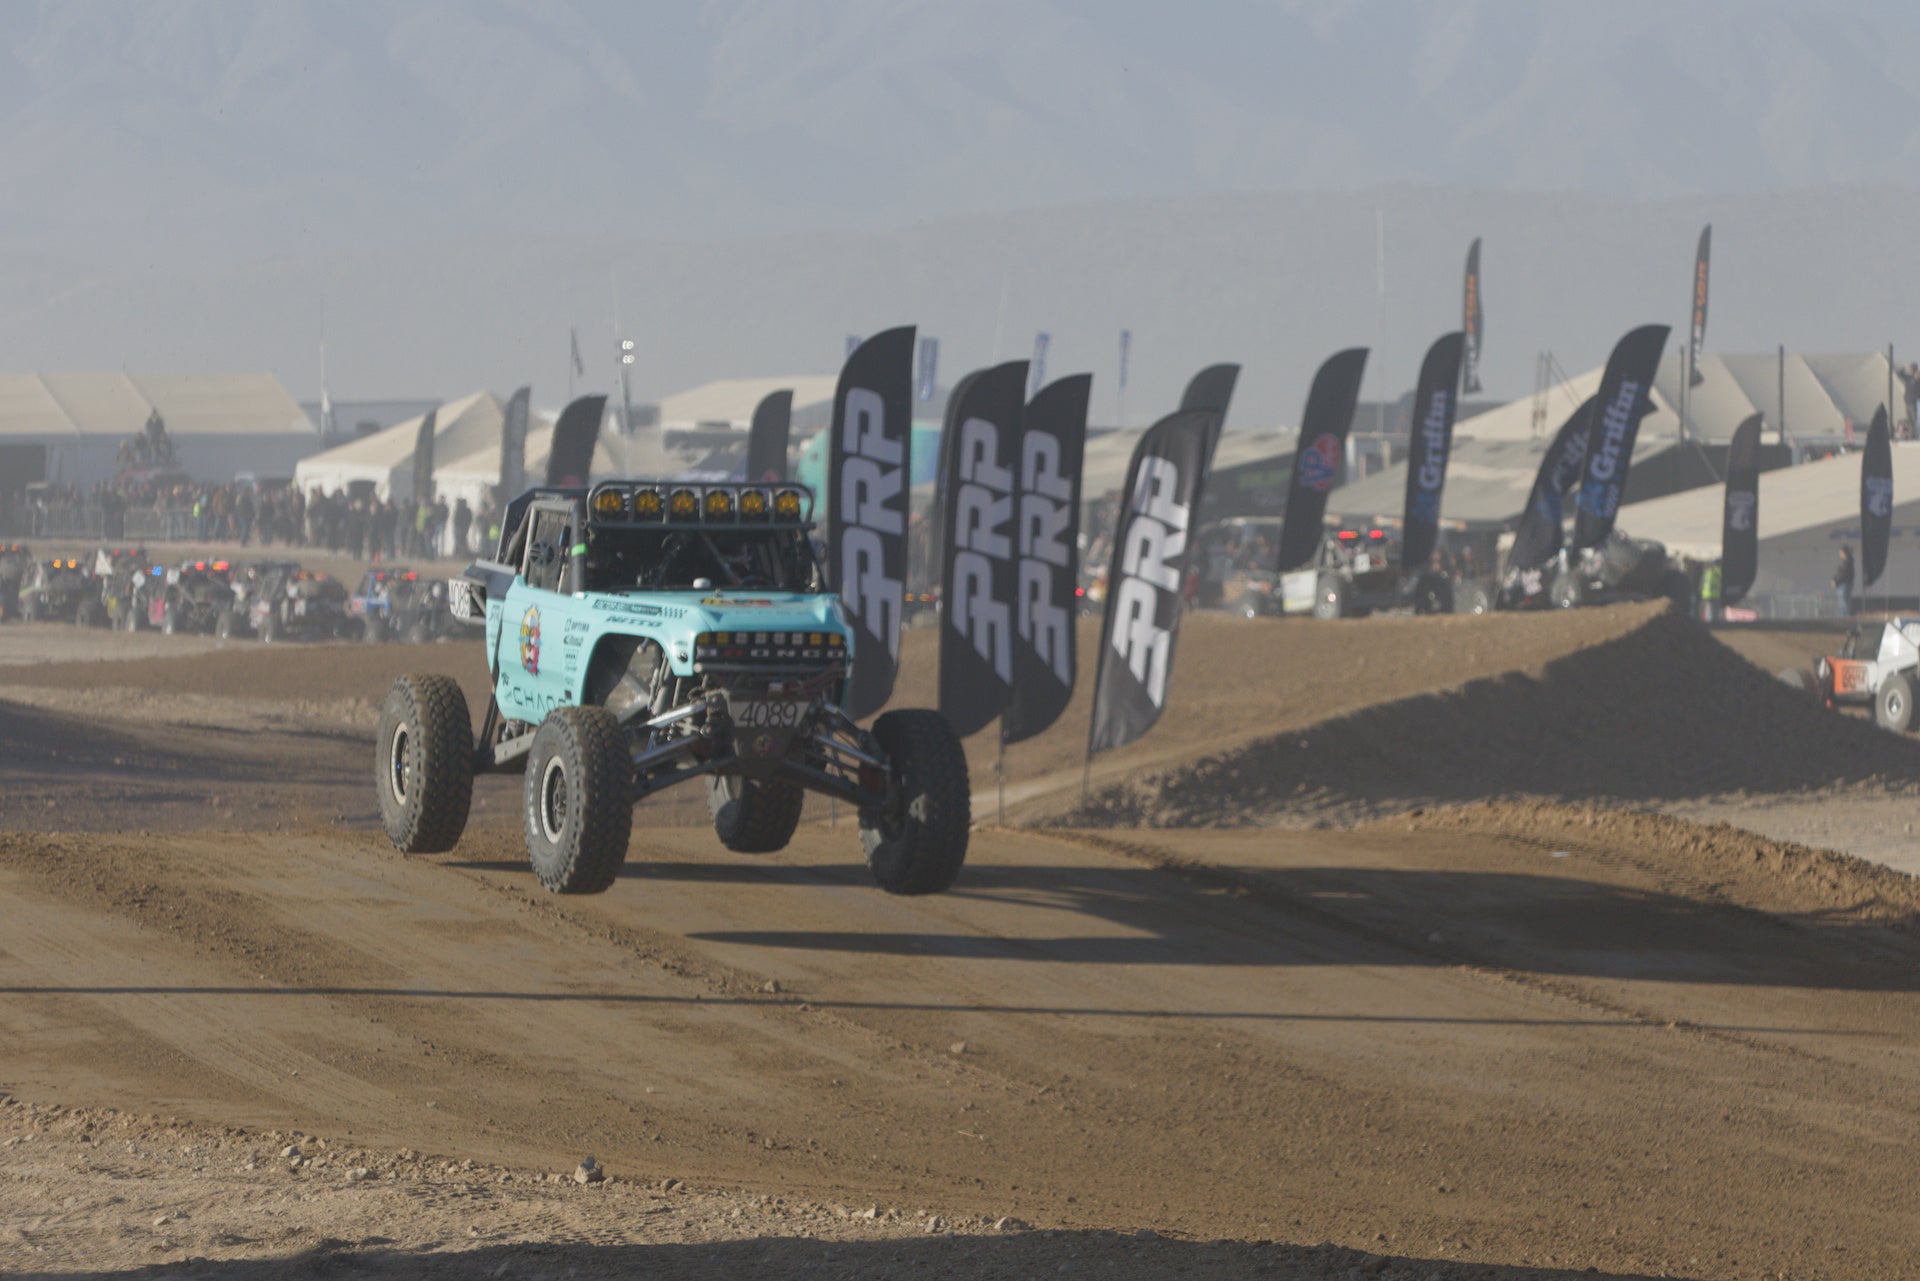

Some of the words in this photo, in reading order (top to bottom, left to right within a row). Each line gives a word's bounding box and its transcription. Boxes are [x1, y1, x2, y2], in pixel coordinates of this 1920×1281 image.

[1418, 391, 1448, 490] Griffin
[1590, 380, 1639, 481] Griffin
[842, 386, 904, 665] PRP
[951, 416, 1014, 686] PRP
[1017, 429, 1073, 688] PRP
[1111, 455, 1190, 709] PRP
[697, 649, 845, 660] BRONCO
[738, 701, 798, 729] 4089
